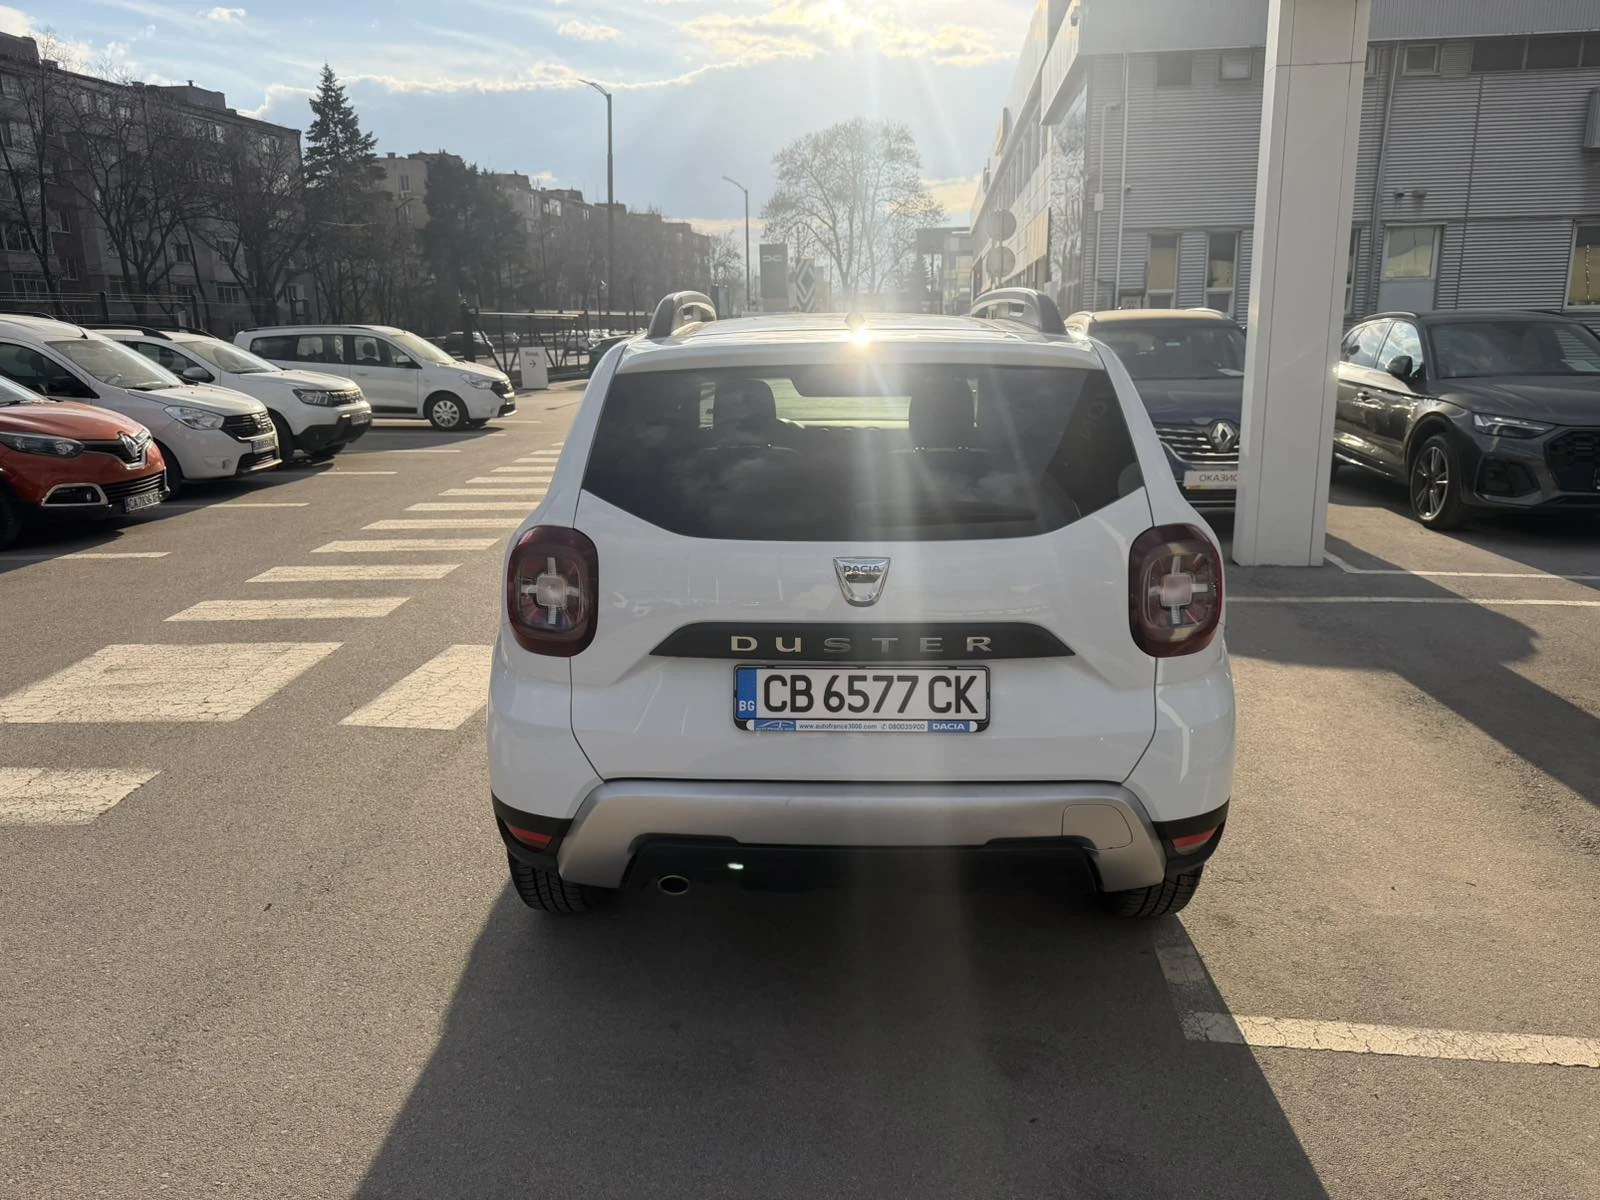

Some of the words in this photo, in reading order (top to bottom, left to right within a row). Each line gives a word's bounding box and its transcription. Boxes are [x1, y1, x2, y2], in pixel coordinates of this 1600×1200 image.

[844, 565, 881, 573] DACIA
[730, 635, 993, 653] DUSTER
[764, 674, 814, 713] CB
[823, 674, 920, 714] 6577
[928, 675, 979, 714] CK
[739, 700, 755, 711] BG
[799, 722, 878, 731] www.autofrance3000.com
[932, 723, 966, 731] DACIA
